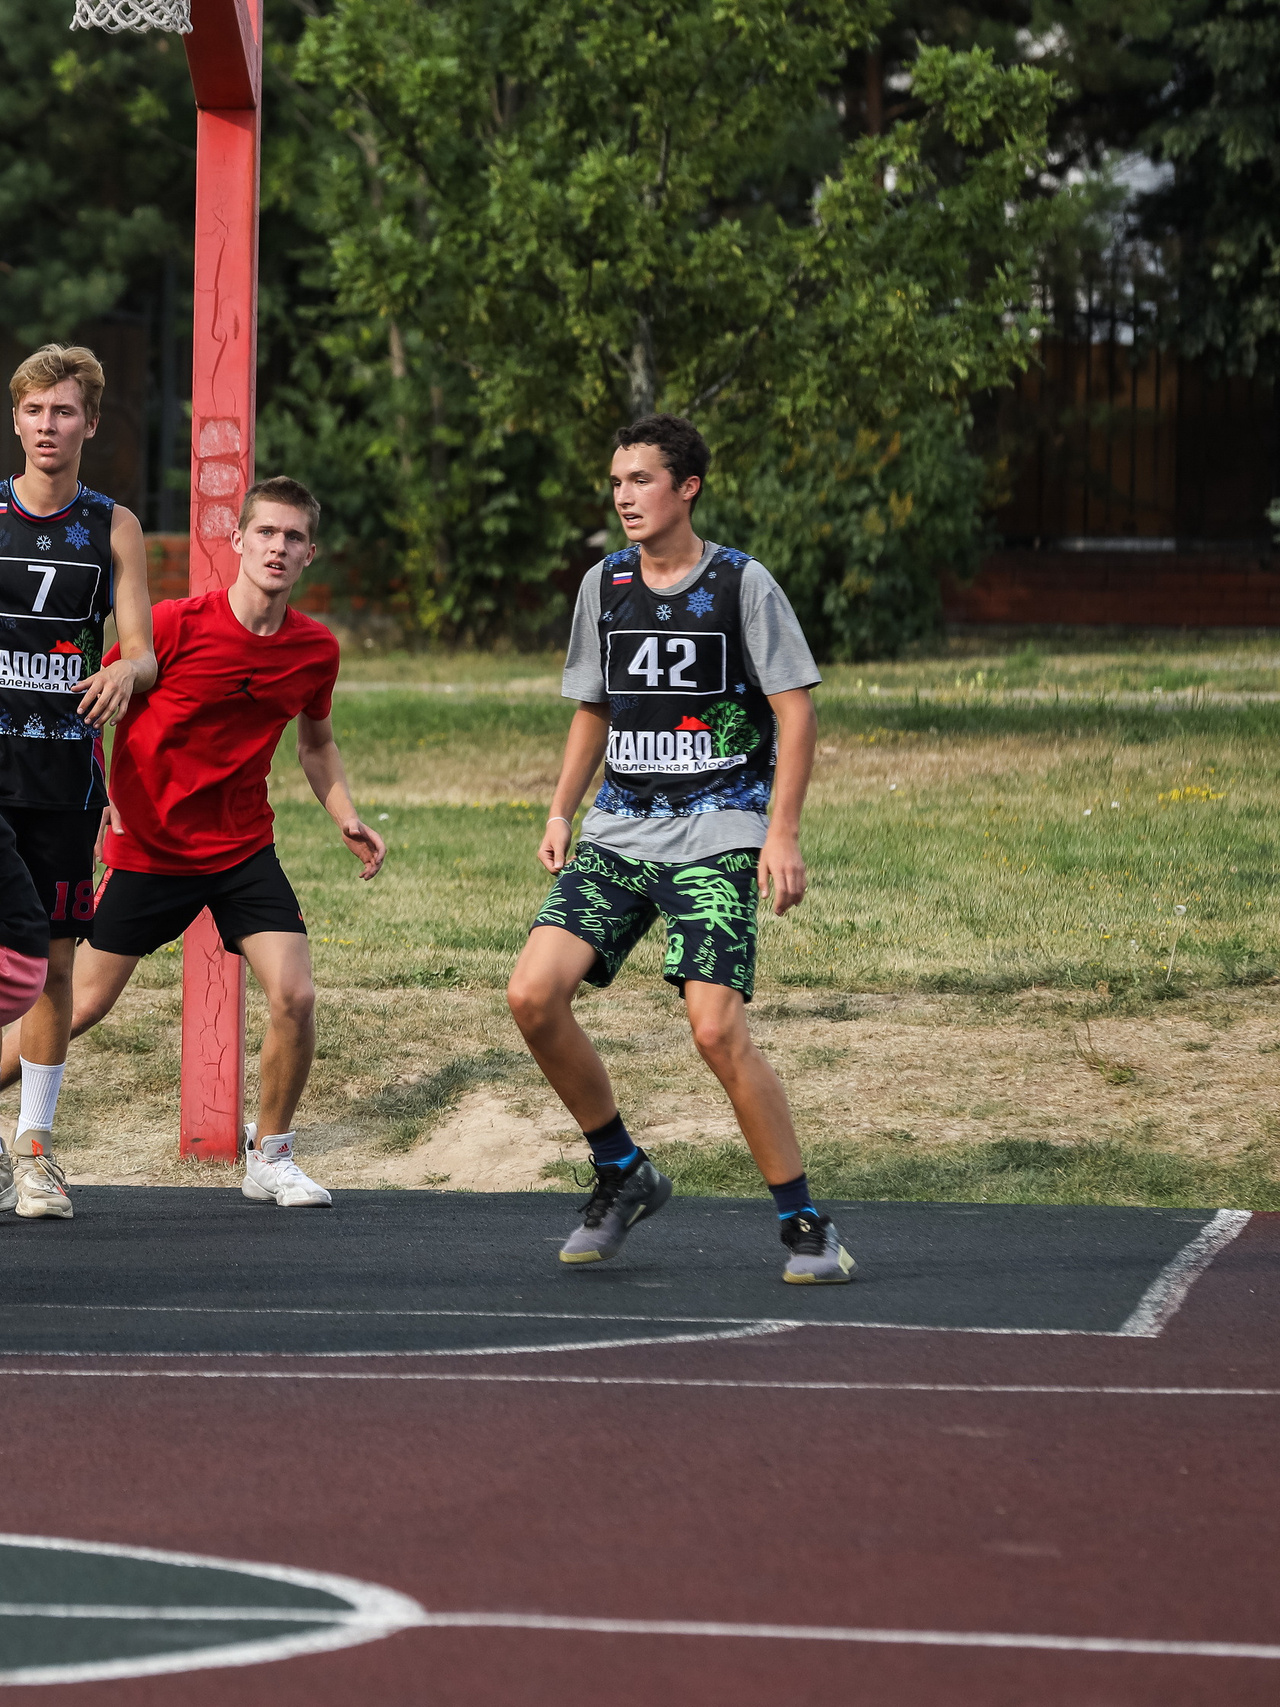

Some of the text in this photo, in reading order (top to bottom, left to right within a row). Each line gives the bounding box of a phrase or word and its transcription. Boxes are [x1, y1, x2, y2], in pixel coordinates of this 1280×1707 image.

[27, 564, 57, 613] 7
[627, 636, 698, 689] 42
[51, 880, 95, 921] 18
